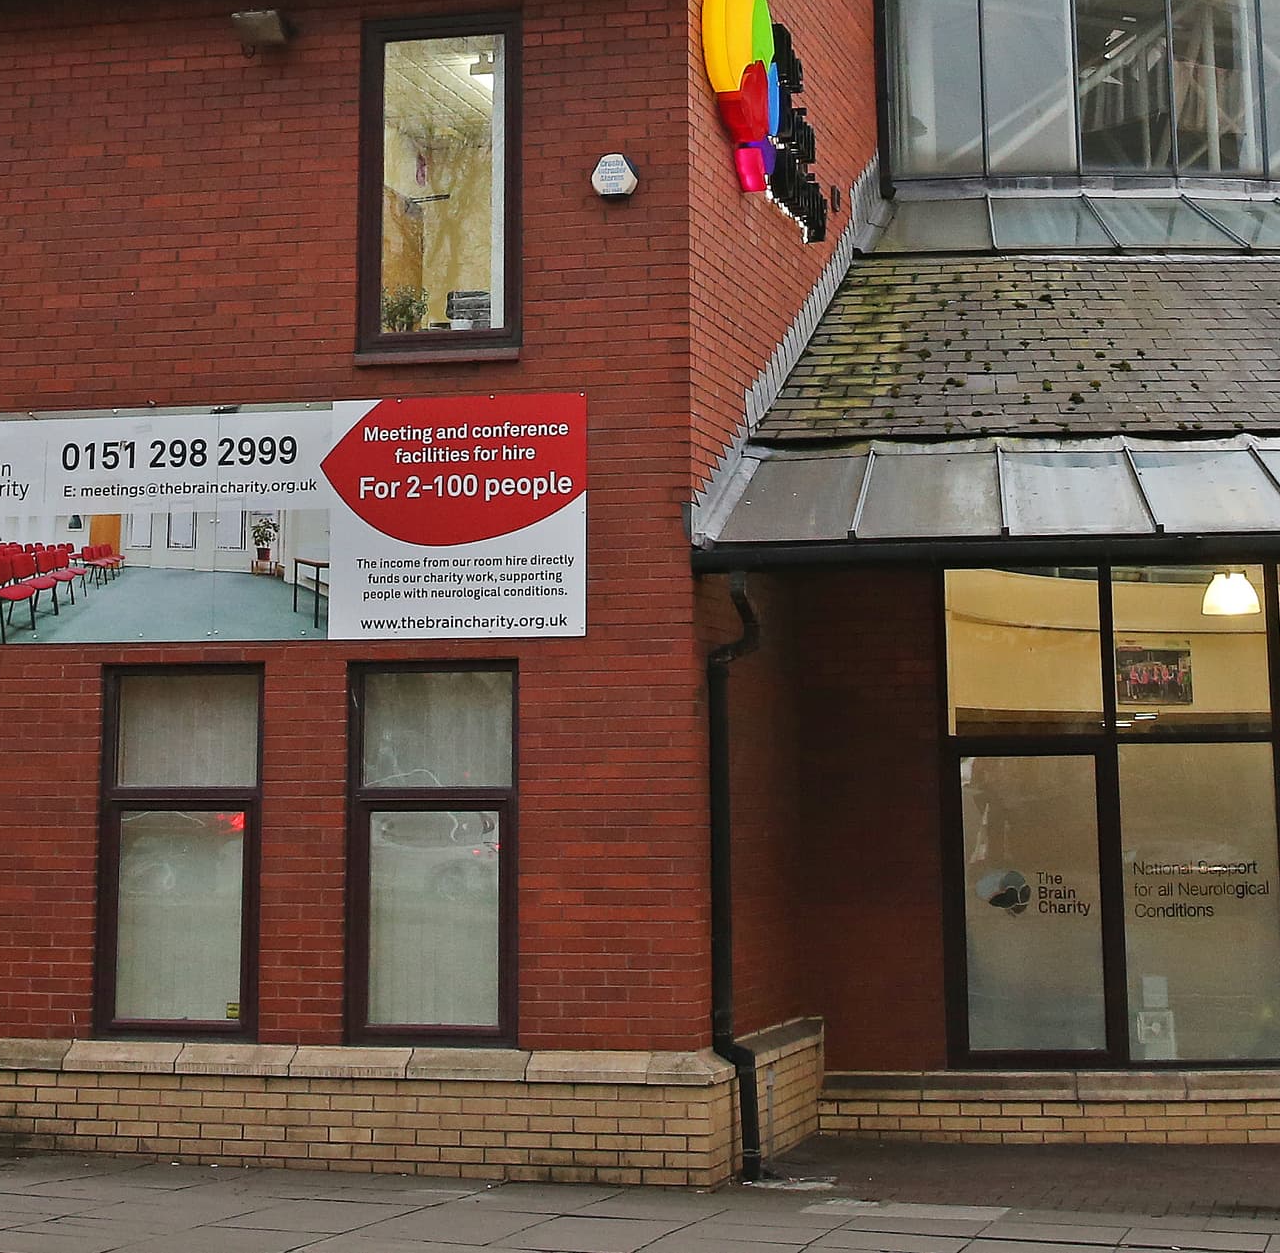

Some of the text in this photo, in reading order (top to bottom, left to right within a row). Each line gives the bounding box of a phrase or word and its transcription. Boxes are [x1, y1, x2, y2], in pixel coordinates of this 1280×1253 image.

[363, 422, 569, 443] Meeting and conference
[62, 436, 297, 470] 0151 298 2999
[395, 445, 535, 464] facilities for hire
[64, 479, 317, 497] E: meetings@thebraincharity.org.uk
[359, 471, 573, 501] For 2-100 people
[357, 554, 574, 569] The income from our room hire directly
[368, 570, 562, 584] funds our charity work, supporting
[363, 585, 567, 601] people with neurological conditions.
[360, 614, 568, 629] www.thebraincharity.org.uk
[1133, 860, 1258, 876] National Support
[1036, 872, 1062, 884] The
[1038, 886, 1075, 899] Brain
[1134, 880, 1269, 898] for all Neurological
[1039, 900, 1090, 916] Charity
[1134, 903, 1214, 917] Conditions
